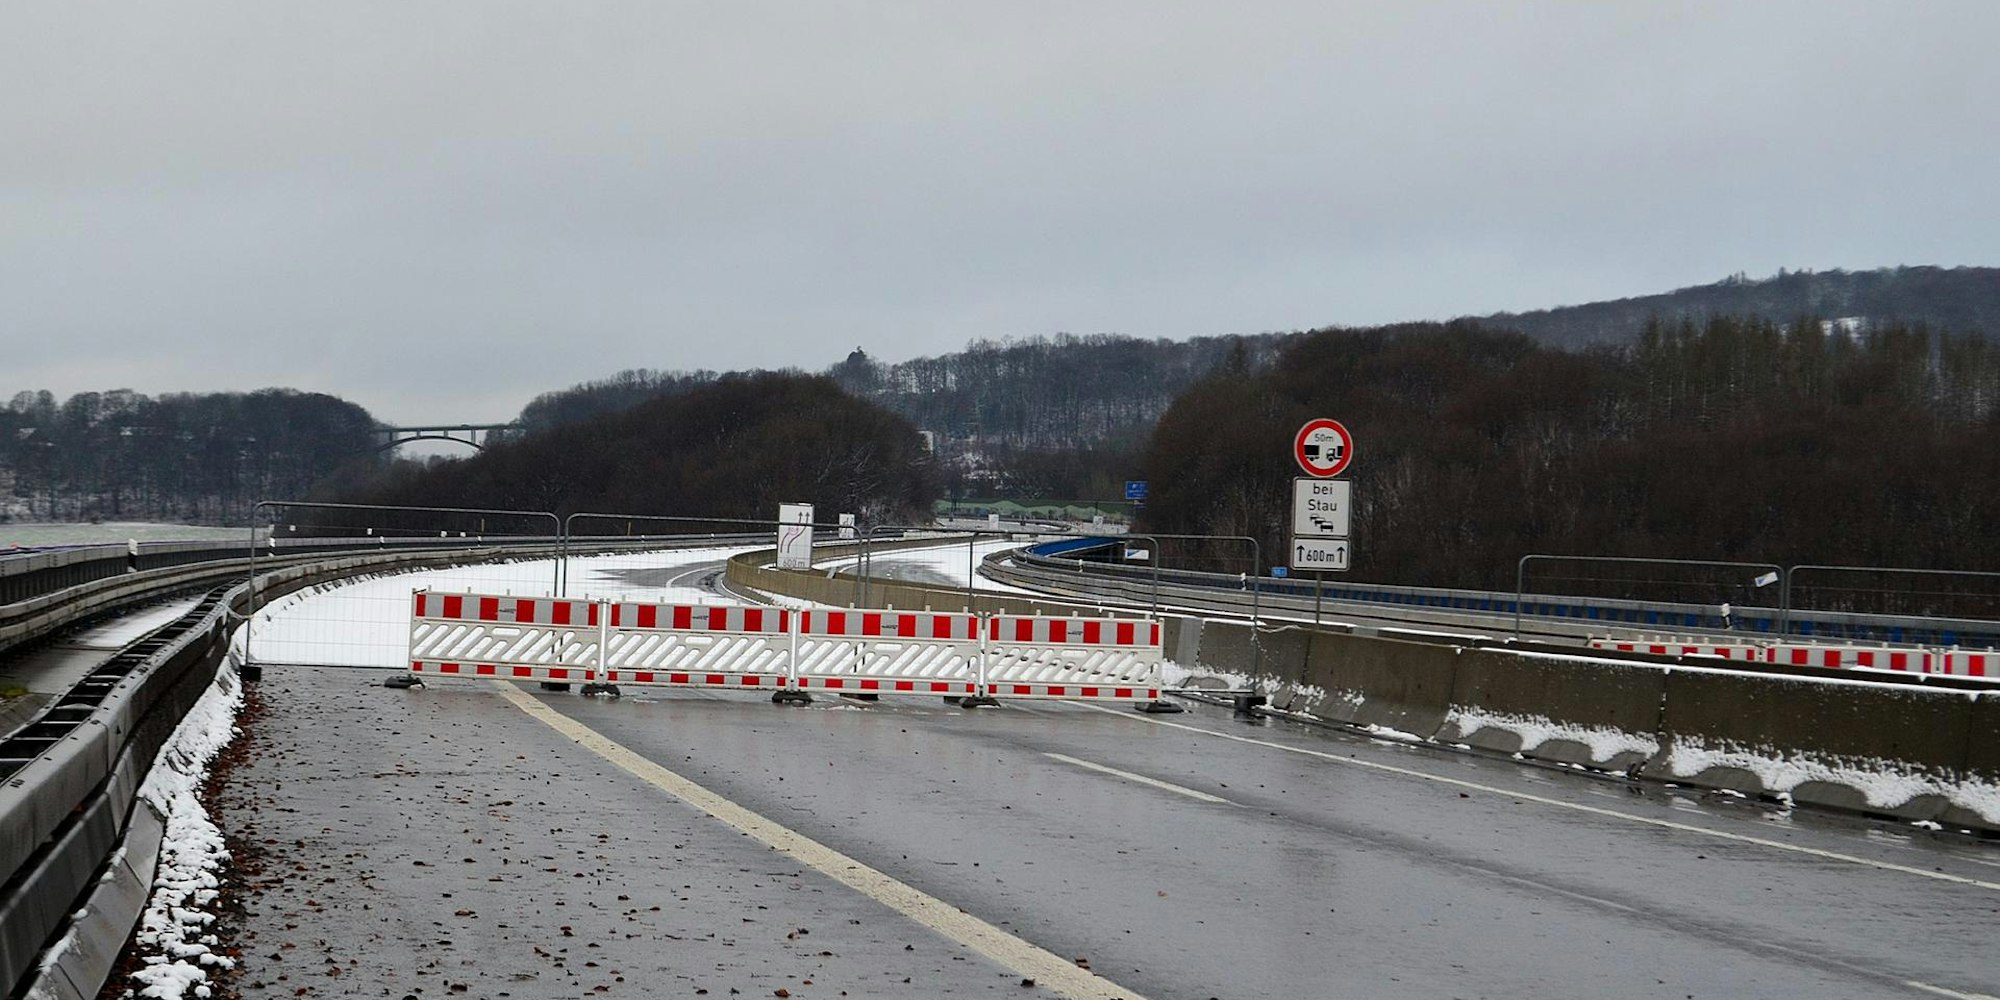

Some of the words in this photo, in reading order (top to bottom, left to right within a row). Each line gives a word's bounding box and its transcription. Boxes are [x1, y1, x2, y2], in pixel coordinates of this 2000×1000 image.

[1314, 433, 1333, 442] 50m
[1313, 483, 1333, 495] bei
[1308, 499, 1337, 511] Stau
[1306, 549, 1335, 562] 600m
